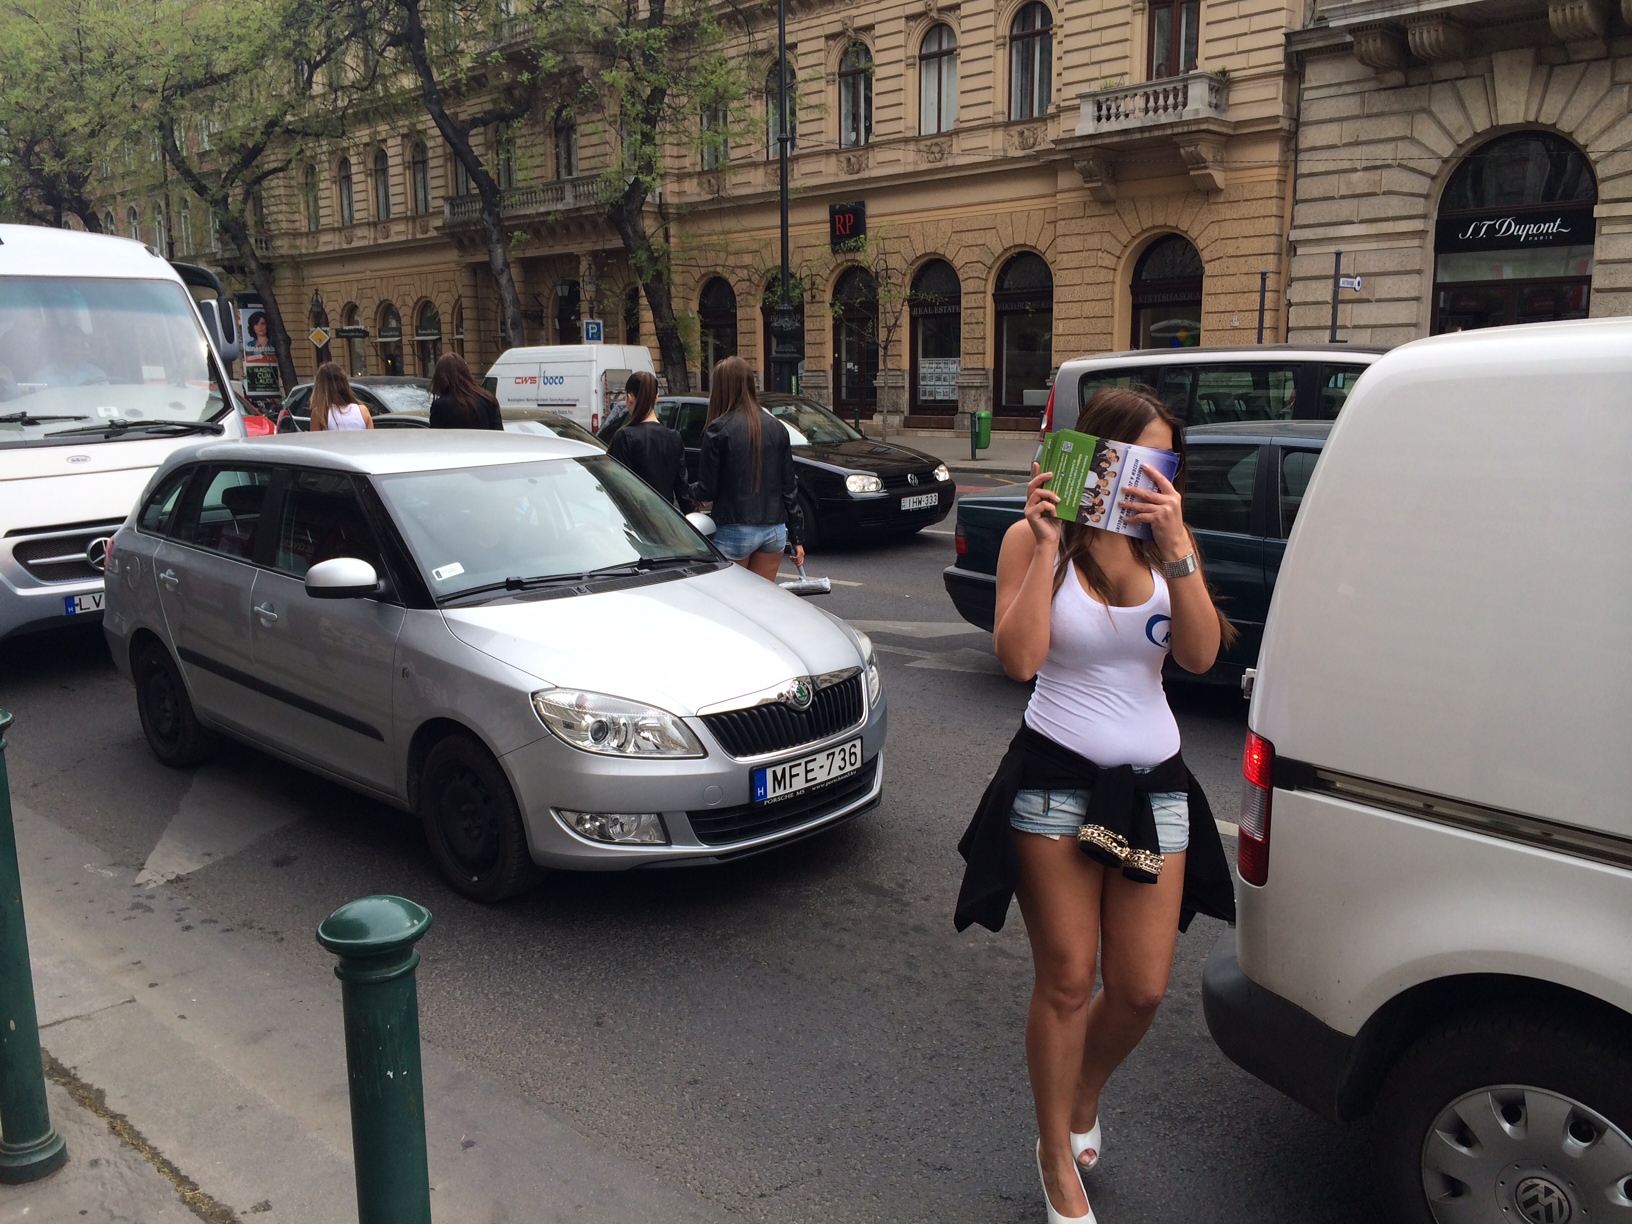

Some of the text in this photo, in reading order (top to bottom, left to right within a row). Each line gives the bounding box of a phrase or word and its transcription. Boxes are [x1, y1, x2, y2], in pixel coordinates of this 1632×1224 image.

[835, 213, 855, 235] RP
[1494, 216, 1572, 242] Dupont
[912, 304, 961, 316] REAL ESTATE
[588, 324, 598, 338] P
[514, 370, 565, 386] CWS boco
[757, 743, 858, 797] H MFE-736
